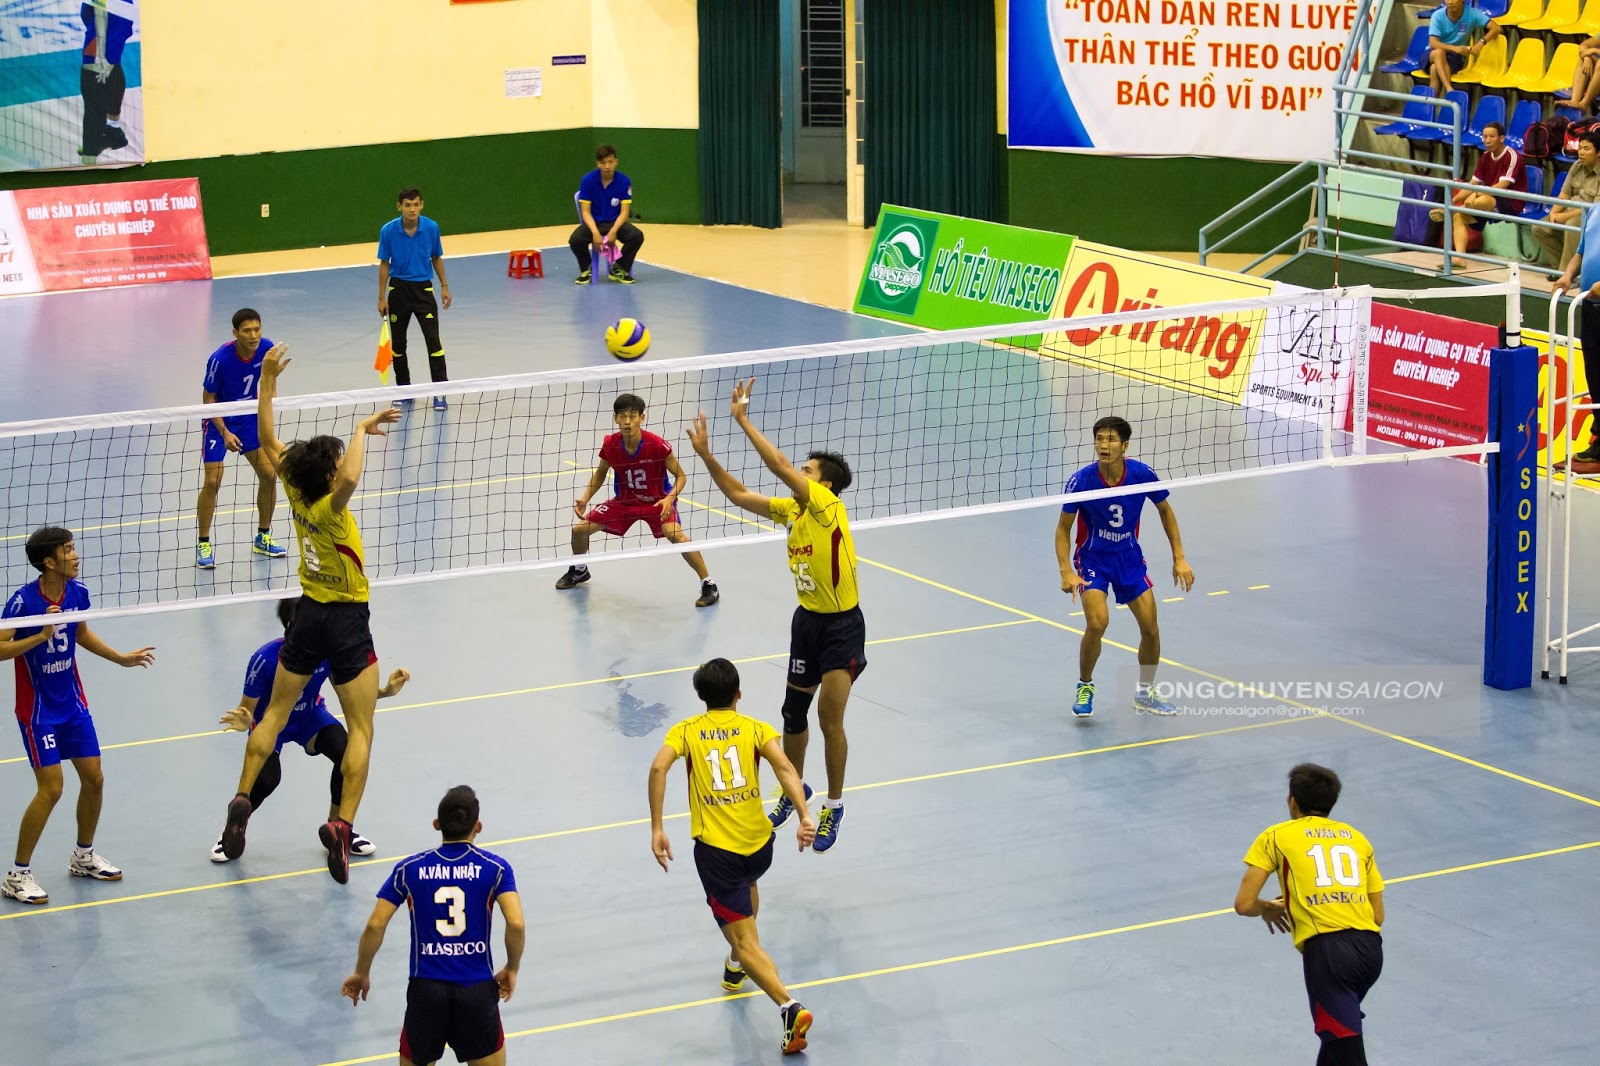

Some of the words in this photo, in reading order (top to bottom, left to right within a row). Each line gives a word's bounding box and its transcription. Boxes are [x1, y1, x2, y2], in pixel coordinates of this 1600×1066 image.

[1064, 32, 1135, 65] THÂN
[1145, 28, 1199, 67] THỂ
[1208, 43, 1279, 70] THEO
[1116, 75, 1171, 106] BÁC
[1180, 72, 1216, 109] HỒ
[1226, 78, 1253, 109] VĨ
[27, 204, 49, 220] NHÀ
[51, 202, 73, 218] SẢN
[75, 199, 101, 217] XUẤT
[104, 202, 132, 217] DỤNG
[133, 199, 148, 215] CỤ
[149, 193, 169, 211] THỂ
[170, 195, 197, 210] THAO
[75, 221, 116, 238] CHUYÊN
[117, 218, 155, 237] NGHIỆP
[2, 273, 23, 282] NETS
[83, 275, 113, 284] HOTLINE
[117, 273, 135, 281] 0967
[869, 264, 922, 288] MASECO
[955, 246, 998, 302] TIÊU
[989, 260, 1060, 314] MASECO
[1064, 262, 1251, 379] Arirang
[1384, 325, 1403, 348] SẢN
[1402, 330, 1426, 352] XUẤT
[1425, 338, 1450, 359] DỤNG
[1449, 342, 1464, 364] CỤ
[1463, 342, 1484, 364] THỂ
[243, 373, 254, 395] 7
[1393, 359, 1428, 381] CHUYÊN
[1426, 367, 1460, 390] NGHIỆP
[1251, 383, 1275, 398] SPORTS
[1275, 386, 1312, 405] EQUIPMENT
[209, 440, 217, 450] 7
[1376, 424, 1401, 439] HOTLINE
[1404, 431, 1419, 442] 0967
[1419, 435, 1428, 444] 99
[1428, 437, 1436, 446] 00
[1437, 439, 1445, 448] 99
[625, 469, 648, 490] 12
[595, 504, 609, 515] 12
[1108, 504, 1124, 528] 3
[1515, 467, 1532, 614] SODEX
[791, 658, 806, 674] 15
[42, 734, 57, 750] 15
[705, 745, 748, 791] 11
[703, 787, 760, 806] MASECO
[419, 864, 450, 880] N.VĂN
[453, 862, 482, 881] NHẬT
[1306, 844, 1361, 887] 10
[1305, 891, 1366, 907] MASECO
[434, 886, 466, 937] 3
[421, 941, 486, 956] MASECO
